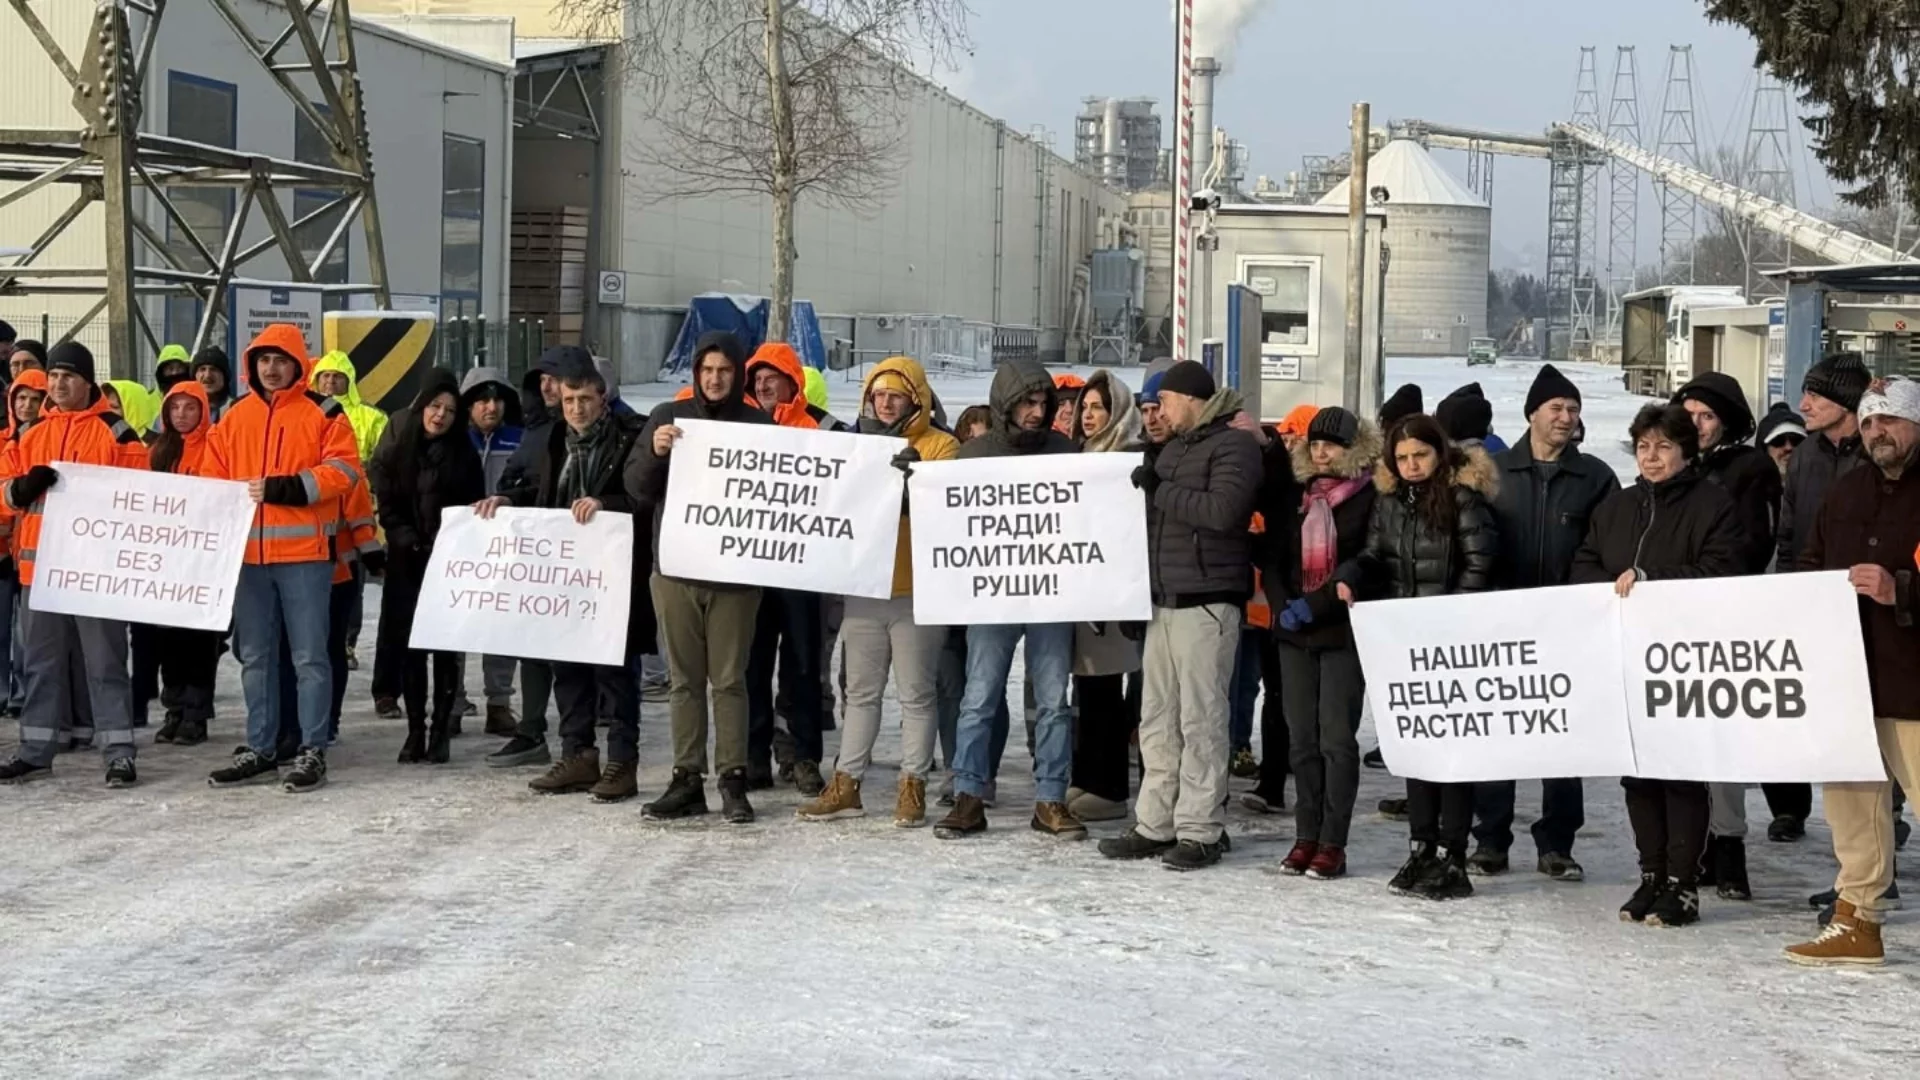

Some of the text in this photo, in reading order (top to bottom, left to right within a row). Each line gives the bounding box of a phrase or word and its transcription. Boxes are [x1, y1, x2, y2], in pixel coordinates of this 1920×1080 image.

[707, 447, 848, 480] БИЗНЕСЪТ
[112, 490, 187, 517] НЕ НИ
[723, 477, 819, 508] ГРАДИ!
[945, 480, 1084, 509] БИЗНЕСЪТ
[72, 516, 220, 552] ОСТАВЯЙТЕ
[683, 503, 855, 541] ПОЛИТИКАТА
[967, 511, 1062, 541] ГРАДИ!
[116, 549, 163, 573] БЕЗ
[484, 535, 575, 560] ДНЕС Е
[719, 534, 806, 565] РУШИ!
[932, 540, 1106, 569] ПОЛИТИКАТА
[444, 560, 609, 592] КРОНОШПАН,
[972, 572, 1059, 599] РУШИ!
[449, 589, 511, 613] УТРЕ
[1409, 639, 1539, 673] НАШИТЕ
[1644, 638, 1805, 675] ОСТАВКА
[1387, 672, 1572, 712] ДЕЦА СЪЩО
[1644, 677, 1808, 720] РИОСВ
[1395, 707, 1569, 740] РАСТАТ ТУК!
